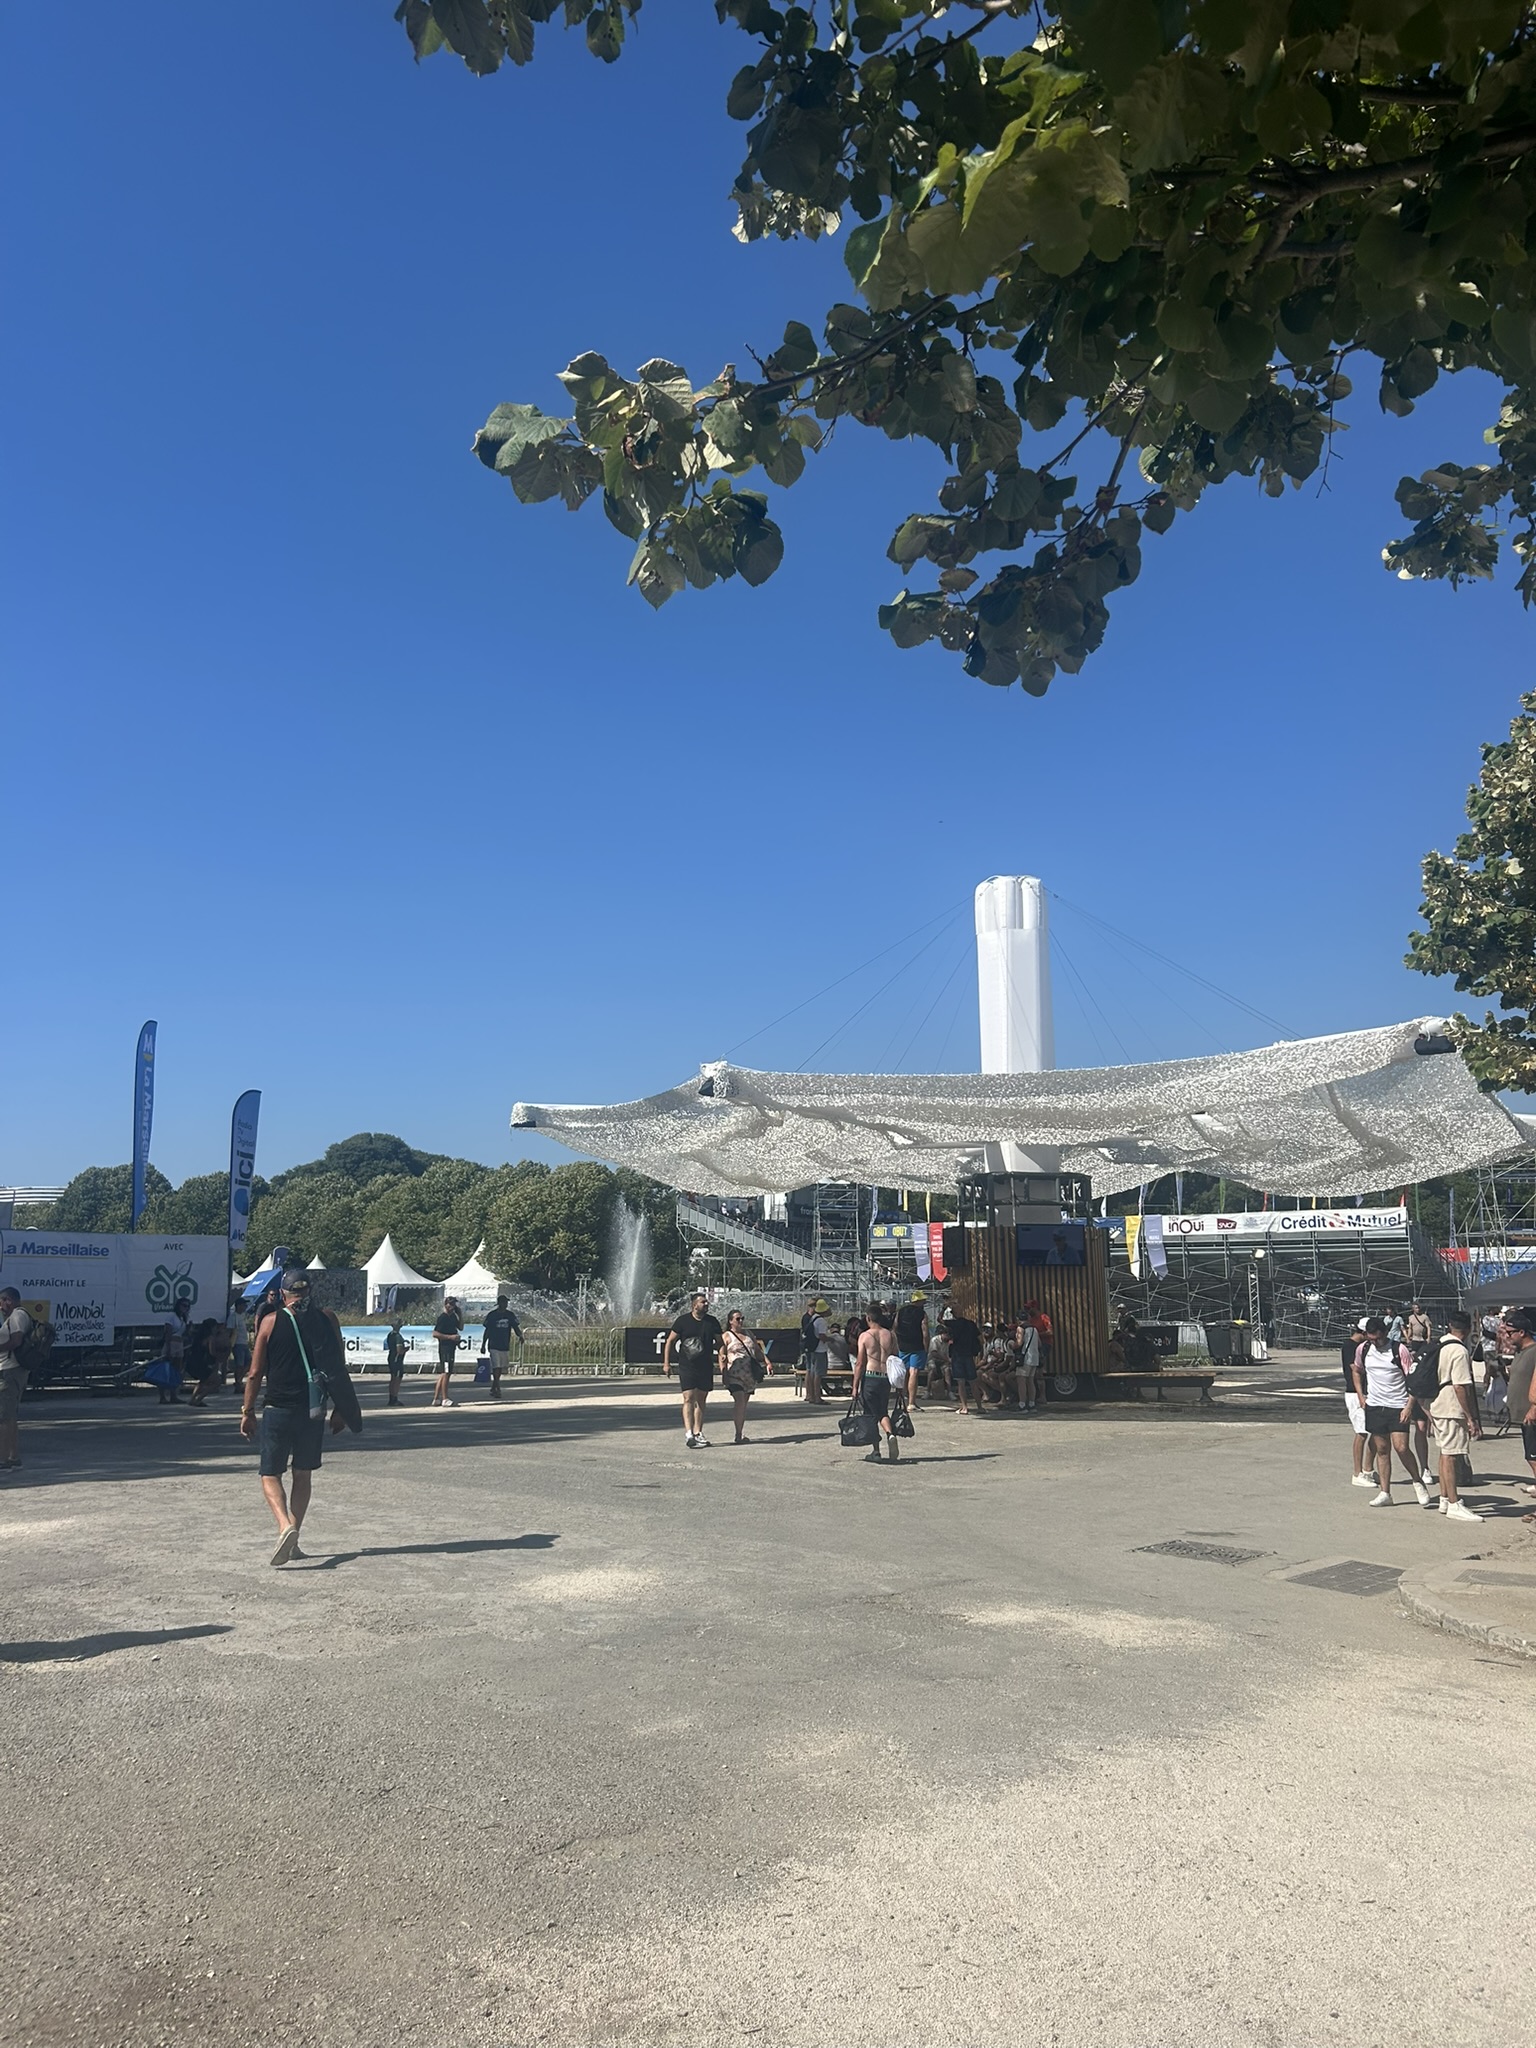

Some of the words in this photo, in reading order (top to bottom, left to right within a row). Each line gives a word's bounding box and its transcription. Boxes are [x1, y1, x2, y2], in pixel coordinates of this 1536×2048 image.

[235, 1150, 254, 1187] ici
[1281, 1216, 1327, 1230] Crédit
[1347, 1213, 1401, 1228] Mutuel
[873, 1226, 888, 1237] OBUT
[892, 1226, 908, 1237] OBUT
[21, 1242, 110, 1257] Marseillaise
[163, 1243, 184, 1251] AVEC
[22, 1277, 74, 1288] RAFRAÎCHIT
[76, 1279, 87, 1288] LE
[63, 1320, 106, 1331] Marseillaise
[343, 1336, 360, 1351] ici
[403, 1336, 415, 1351] ci
[457, 1336, 471, 1351] ci
